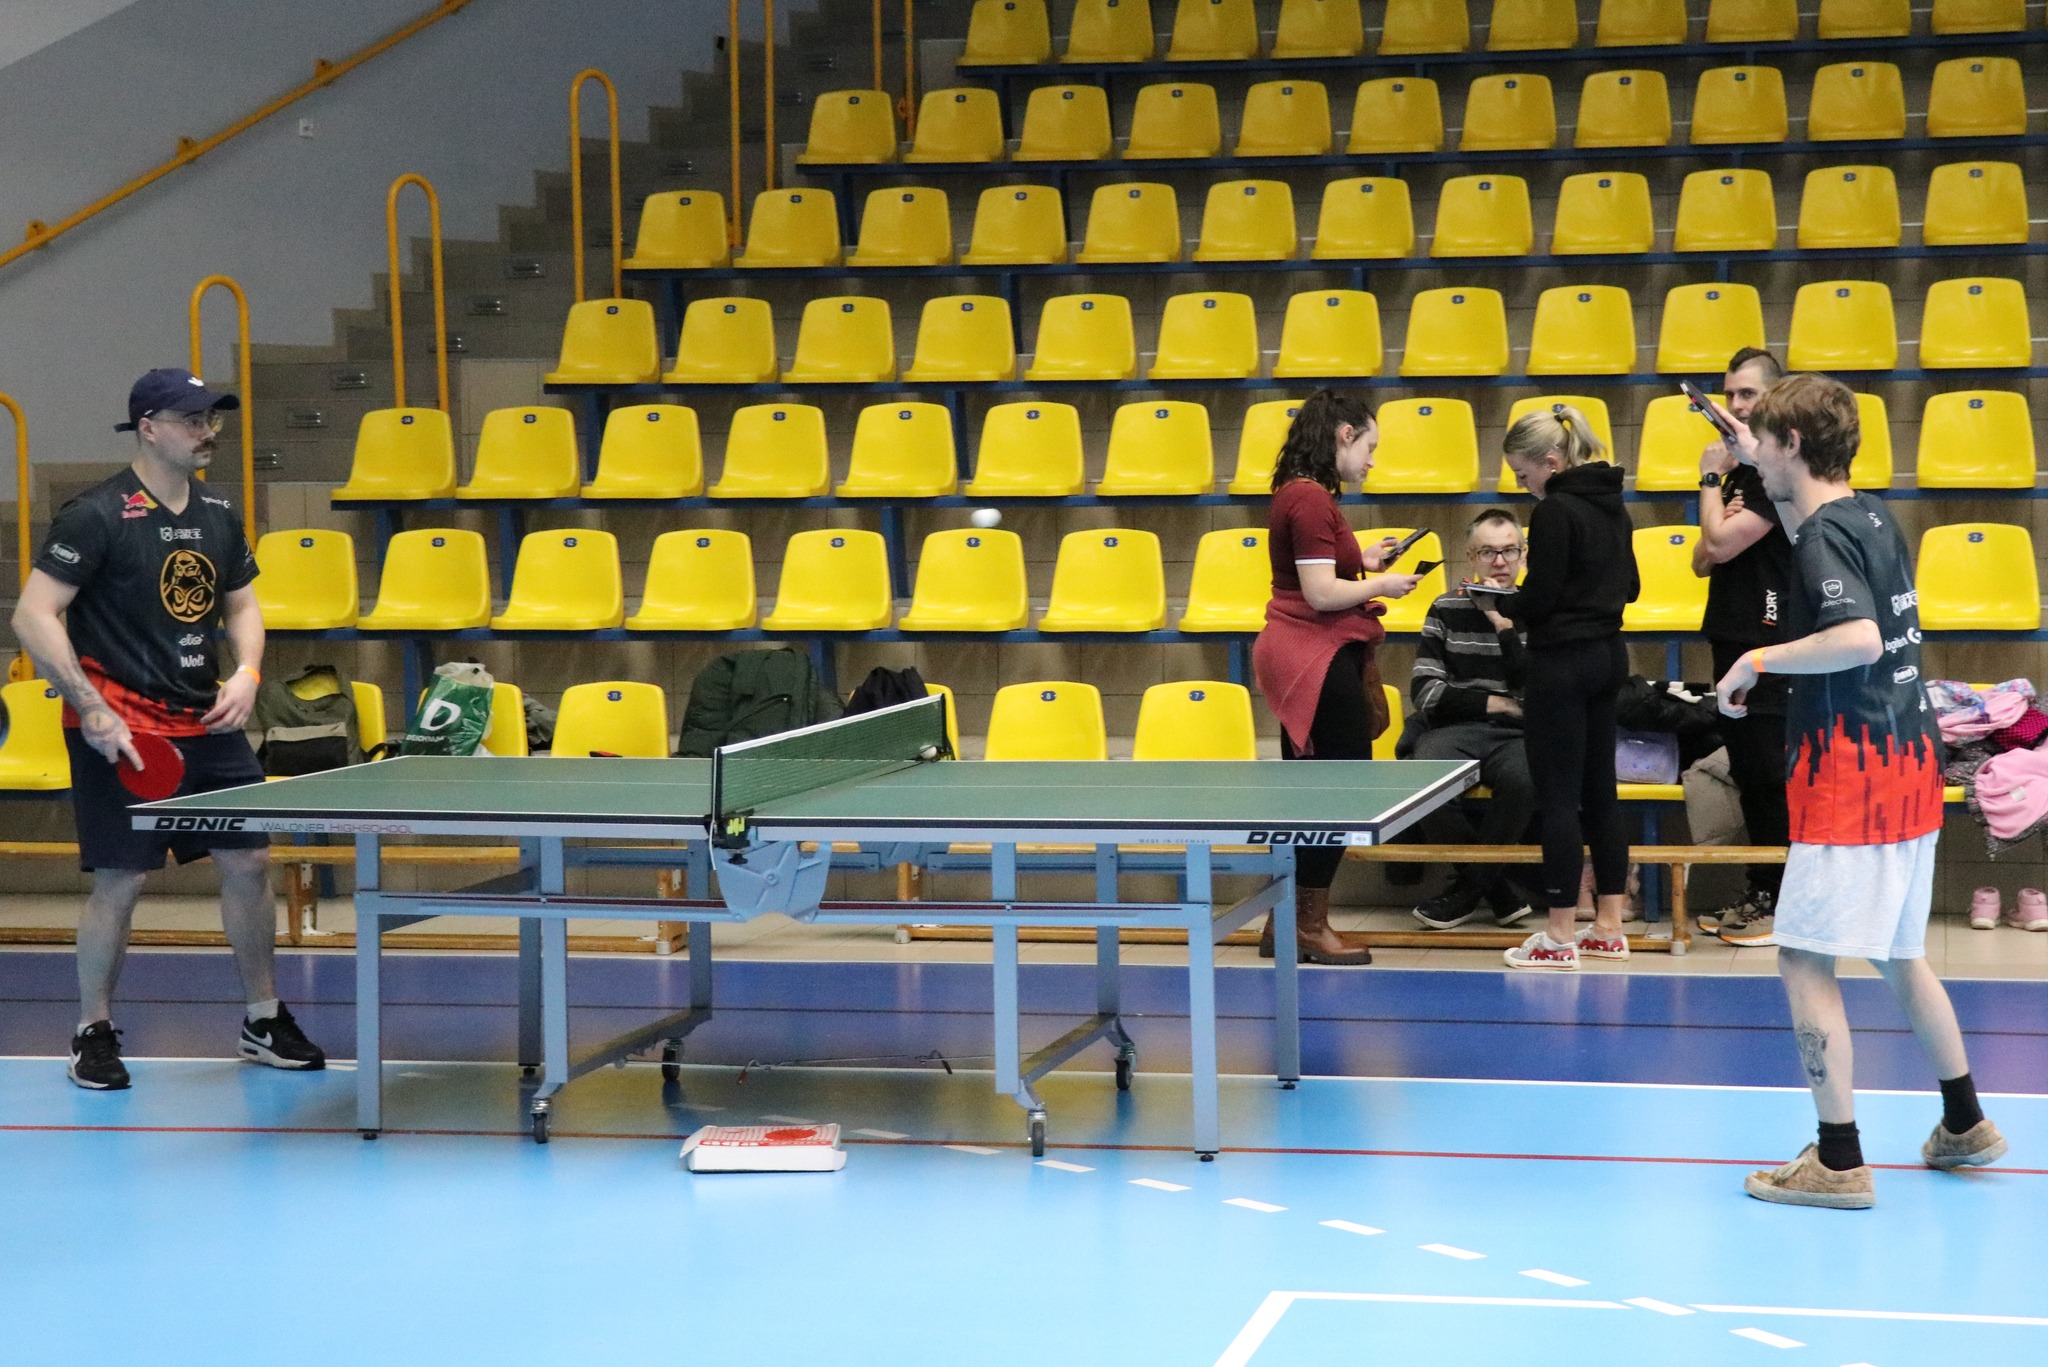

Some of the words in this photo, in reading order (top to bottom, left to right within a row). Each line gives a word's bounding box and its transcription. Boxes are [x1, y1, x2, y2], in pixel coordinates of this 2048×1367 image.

[180, 654, 205, 668] Wolt
[420, 698, 461, 732] D
[154, 817, 247, 831] DONIC
[261, 821, 325, 832] WALDNER
[329, 823, 414, 834] HIGHSCHOOL
[1246, 831, 1347, 845] DONIC
